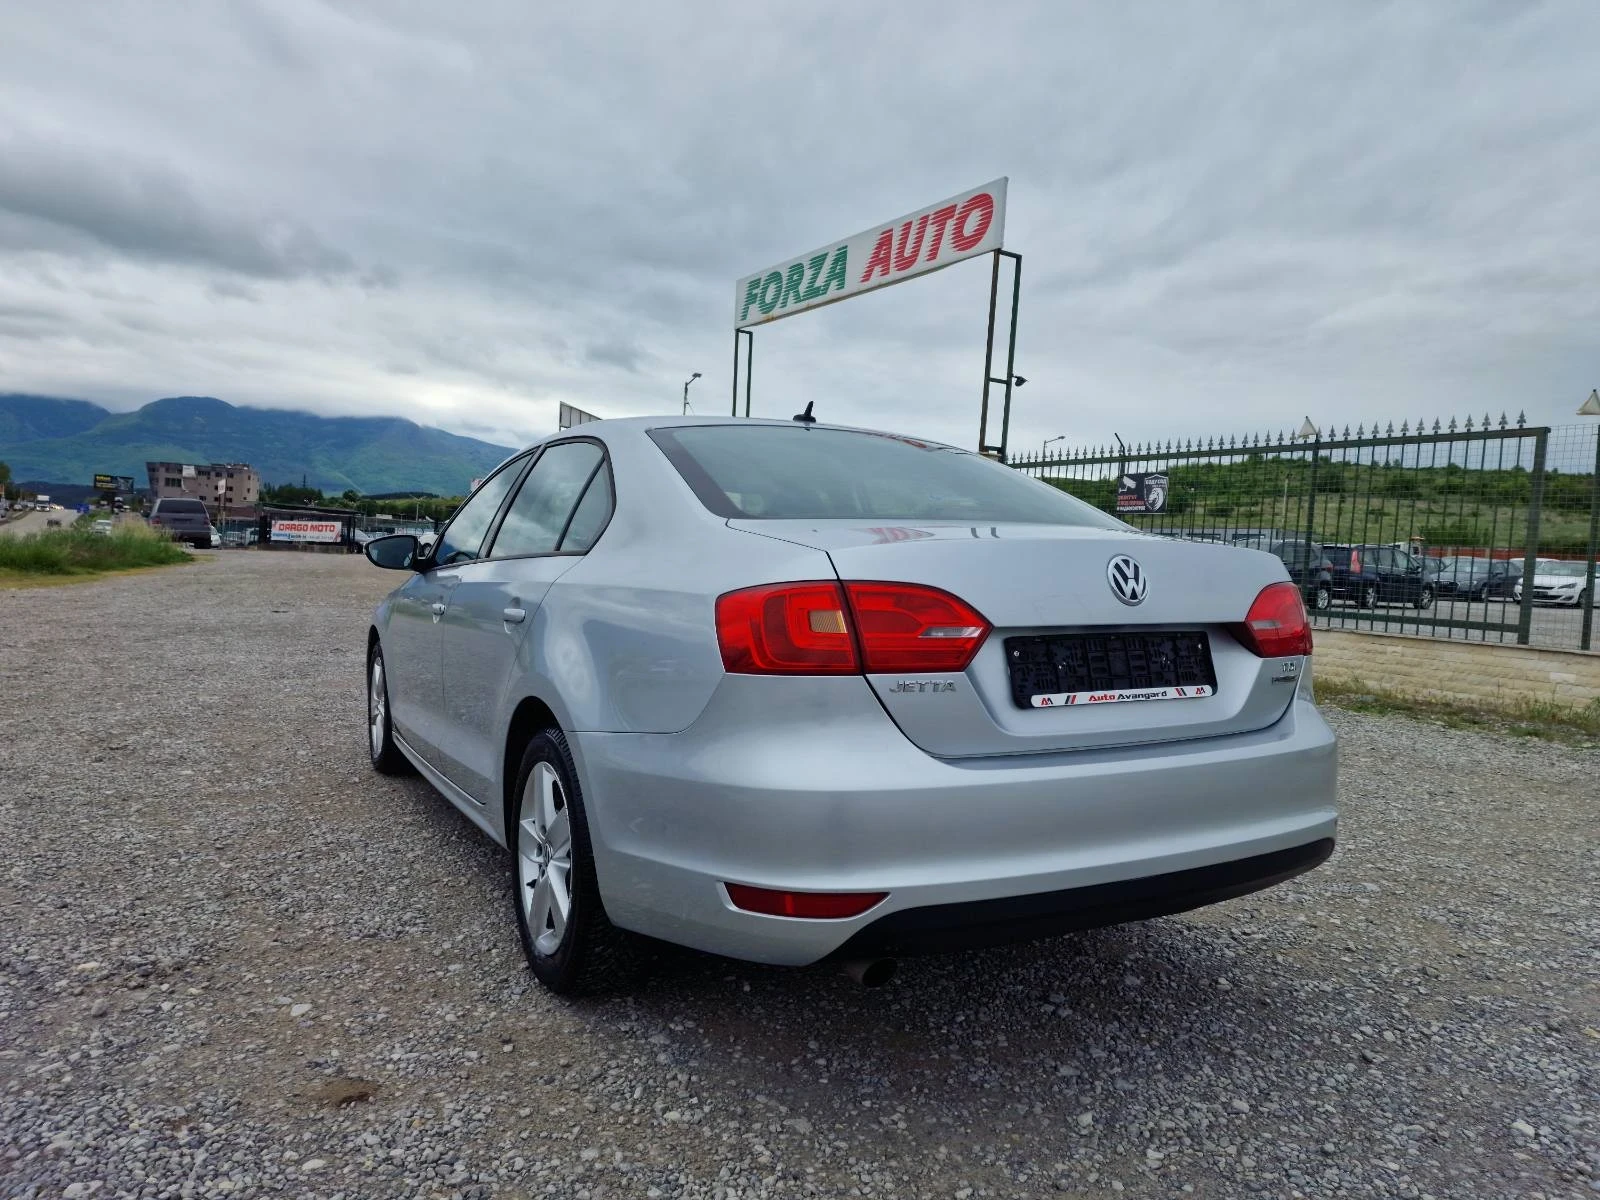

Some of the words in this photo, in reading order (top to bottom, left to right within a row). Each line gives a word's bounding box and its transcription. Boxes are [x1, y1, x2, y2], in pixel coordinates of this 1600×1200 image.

[739, 245, 849, 321] FORZA
[859, 192, 994, 283] AUTO
[310, 524, 336, 533] MOTO
[889, 680, 957, 693] JETTA
[1088, 693, 1116, 702] Auto
[1117, 686, 1168, 701] Avangard
